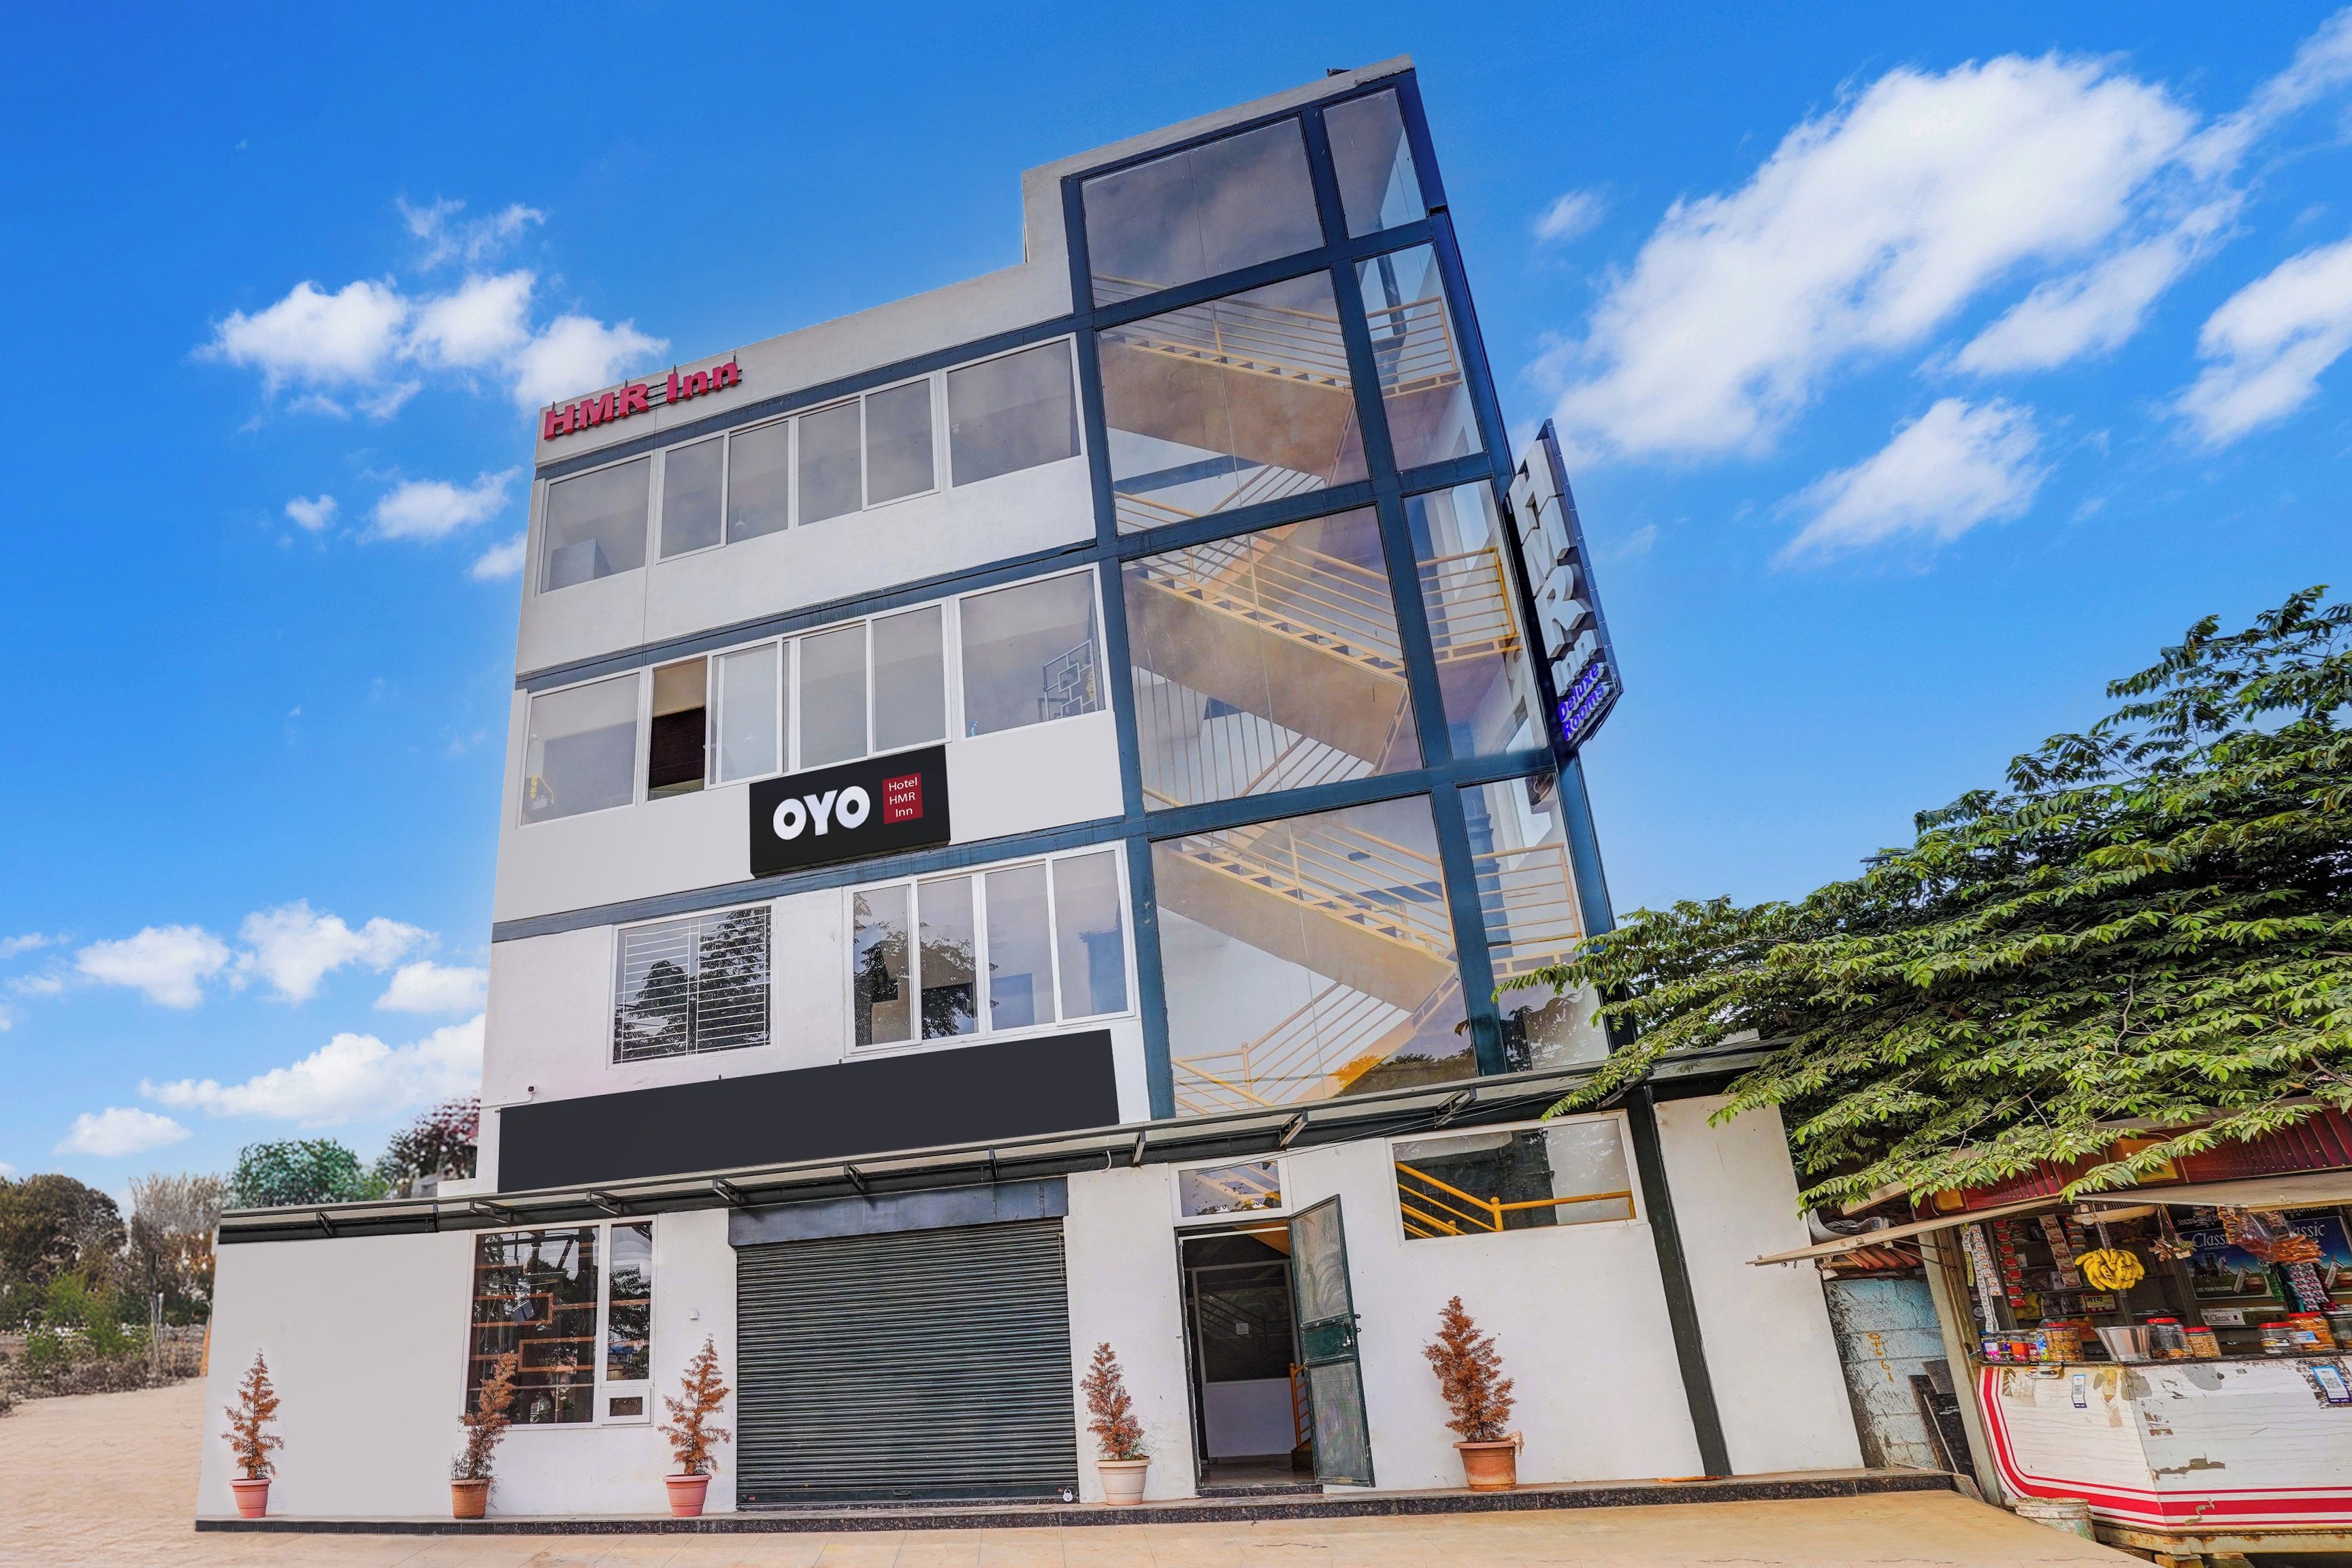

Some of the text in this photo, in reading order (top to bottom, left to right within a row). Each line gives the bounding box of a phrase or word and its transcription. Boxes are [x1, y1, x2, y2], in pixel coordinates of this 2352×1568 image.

[544, 361, 739, 440] HMR Inn
[1509, 439, 1590, 659] HMR
[1551, 630, 1597, 698] Inn
[1558, 662, 1601, 723] Deluxe
[1563, 683, 1607, 741] Rooms
[773, 785, 870, 840] OYO
[888, 777, 917, 792] Hotel
[889, 791, 915, 806] HMR
[895, 807, 913, 818] Inn
